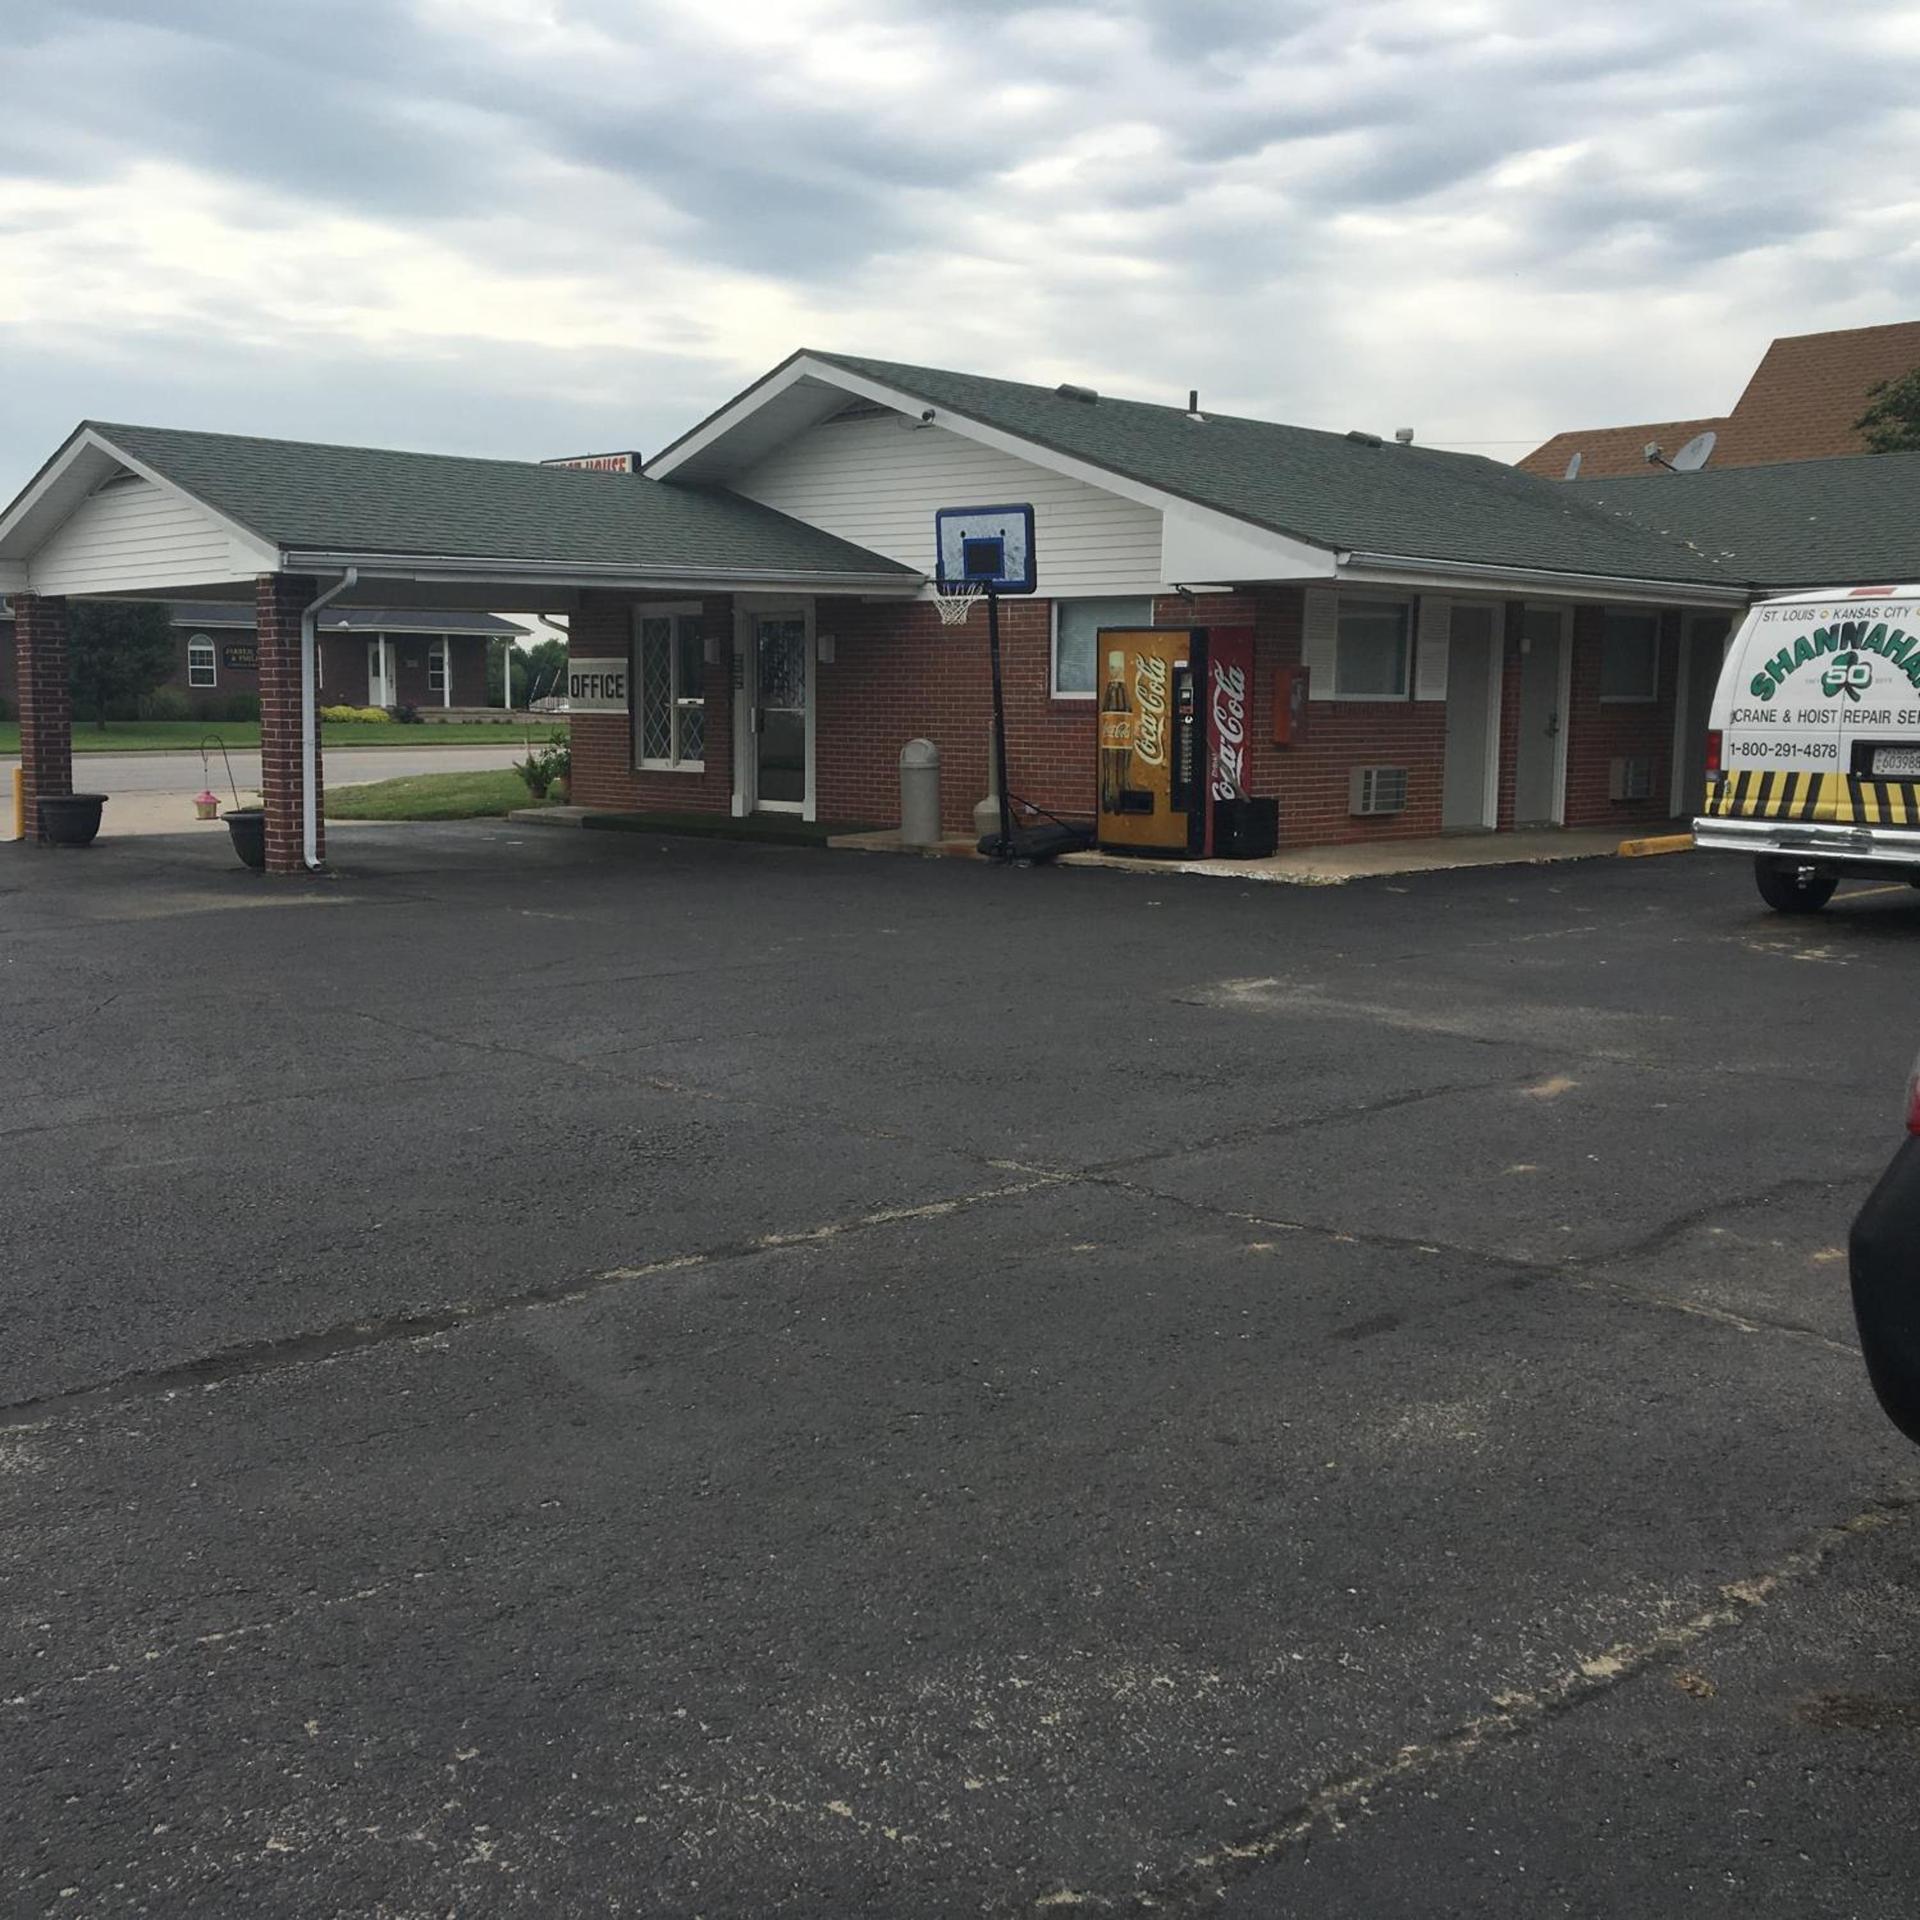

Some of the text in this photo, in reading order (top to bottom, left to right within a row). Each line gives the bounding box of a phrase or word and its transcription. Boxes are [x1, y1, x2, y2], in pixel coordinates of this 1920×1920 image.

[1762, 606, 1912, 622] ST. LOUIS KANSAS CITY
[1750, 621, 1920, 702] SHANNAHA
[1826, 664, 1871, 684] 50
[570, 674, 625, 699] OFFICE
[1734, 709, 1777, 723] CRANE
[1782, 710, 1792, 723] &
[1797, 709, 1838, 723] HOIST
[1843, 709, 1892, 724] REPAIR
[1730, 742, 1838, 758] 1-800-291-4878
